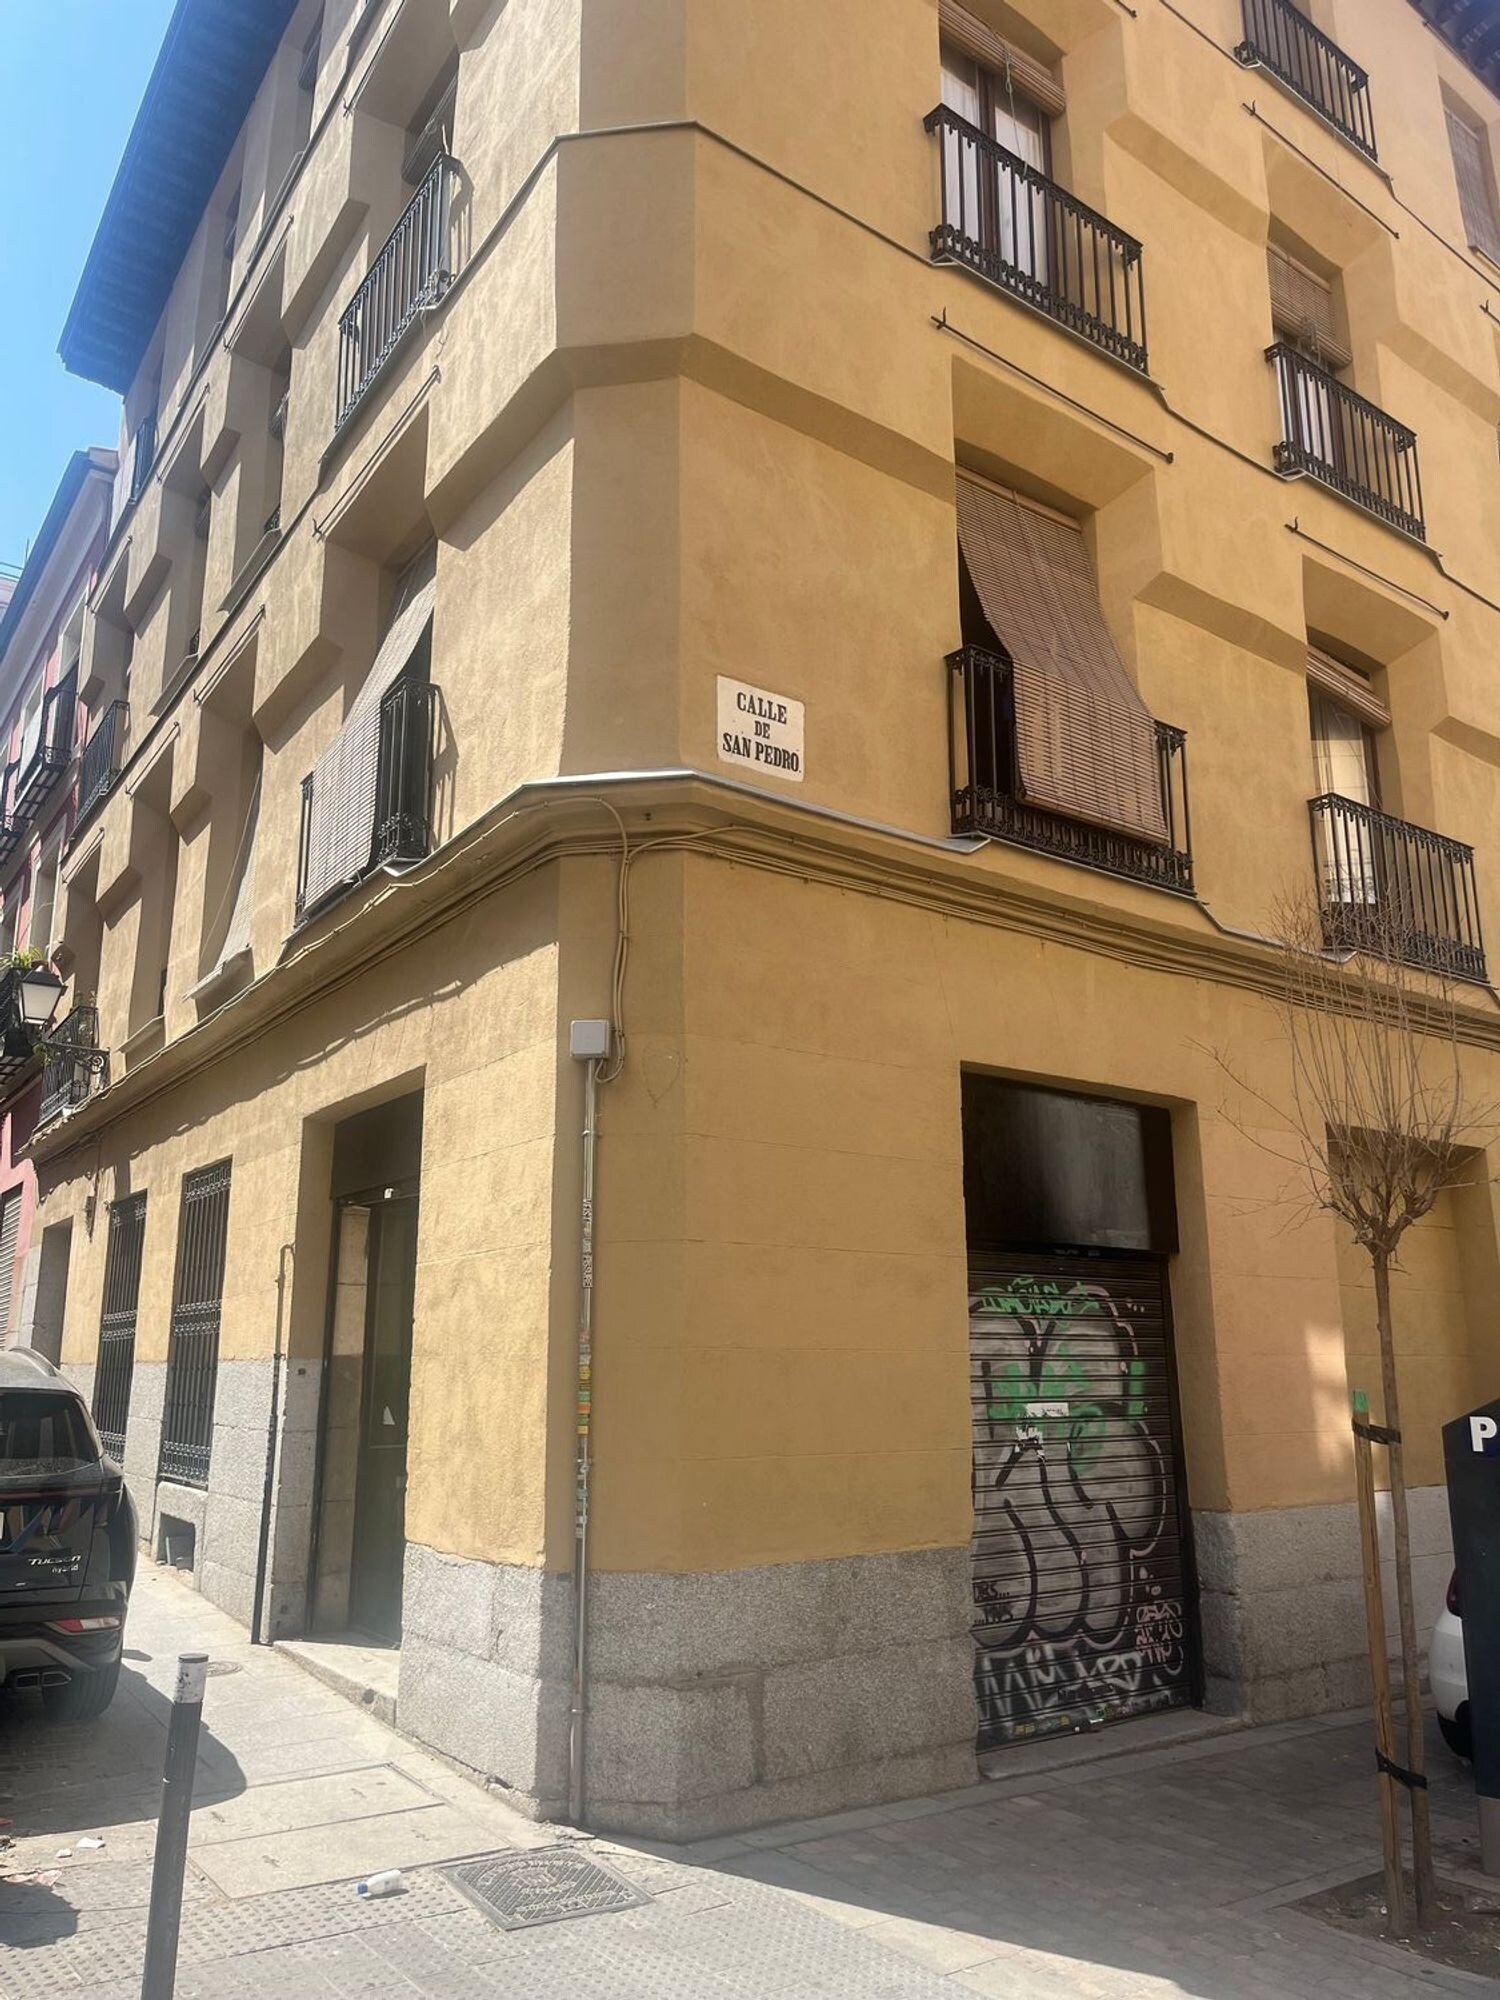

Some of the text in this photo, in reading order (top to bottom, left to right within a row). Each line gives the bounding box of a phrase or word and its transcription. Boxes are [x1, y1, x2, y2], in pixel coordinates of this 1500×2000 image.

[737, 692, 787, 724] CALLE
[754, 720, 770, 739] DE
[723, 732, 751, 758] SAN
[1469, 1416, 1498, 1452] P
